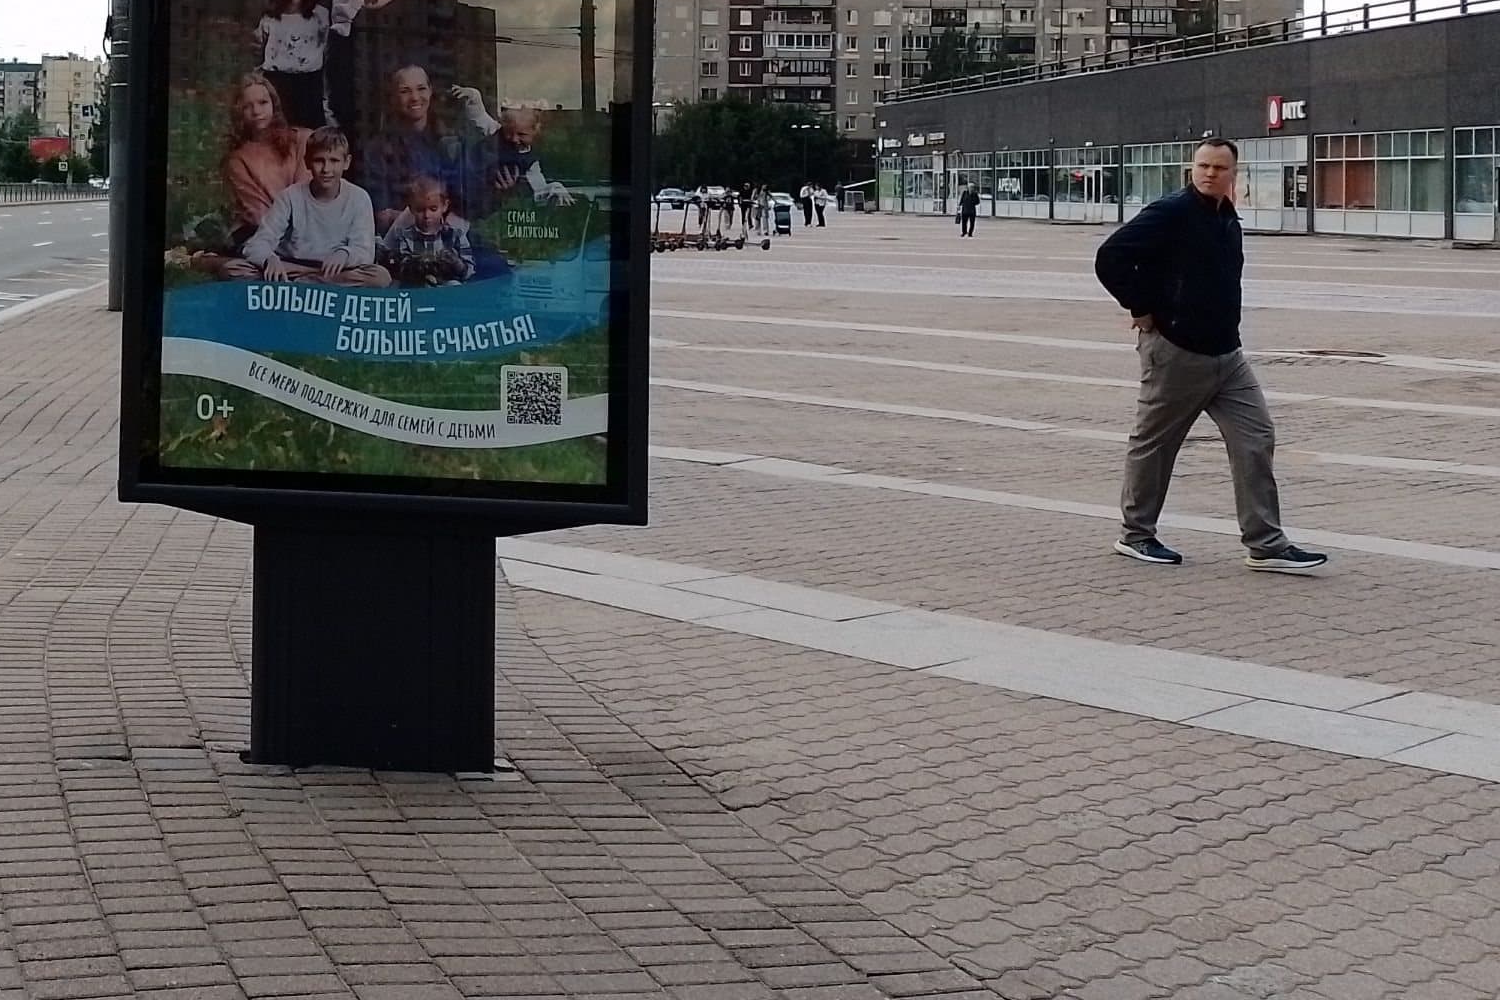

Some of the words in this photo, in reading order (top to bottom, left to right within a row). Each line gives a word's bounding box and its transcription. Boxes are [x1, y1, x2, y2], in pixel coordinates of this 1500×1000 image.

[1282, 101, 1306, 120] МТС
[508, 211, 536, 223] СЕМЬЯ
[247, 285, 338, 318] БОЛЬШЕ
[340, 292, 412, 324] ДЕТЕЙ
[336, 325, 427, 356] БОЛЬШЕ
[433, 313, 537, 355] СЧАСТЬЯ!
[197, 394, 235, 420] 0+
[249, 361, 266, 381] ВСЕ
[269, 371, 300, 394] МЕРЫ
[301, 384, 369, 420] ПОДДЕРЖКИ
[369, 408, 395, 428] ДЛЯ
[398, 415, 435, 435] СЕМЕЙ
[438, 421, 445, 437] С
[446, 423, 496, 440] ДЕТЬМИ
